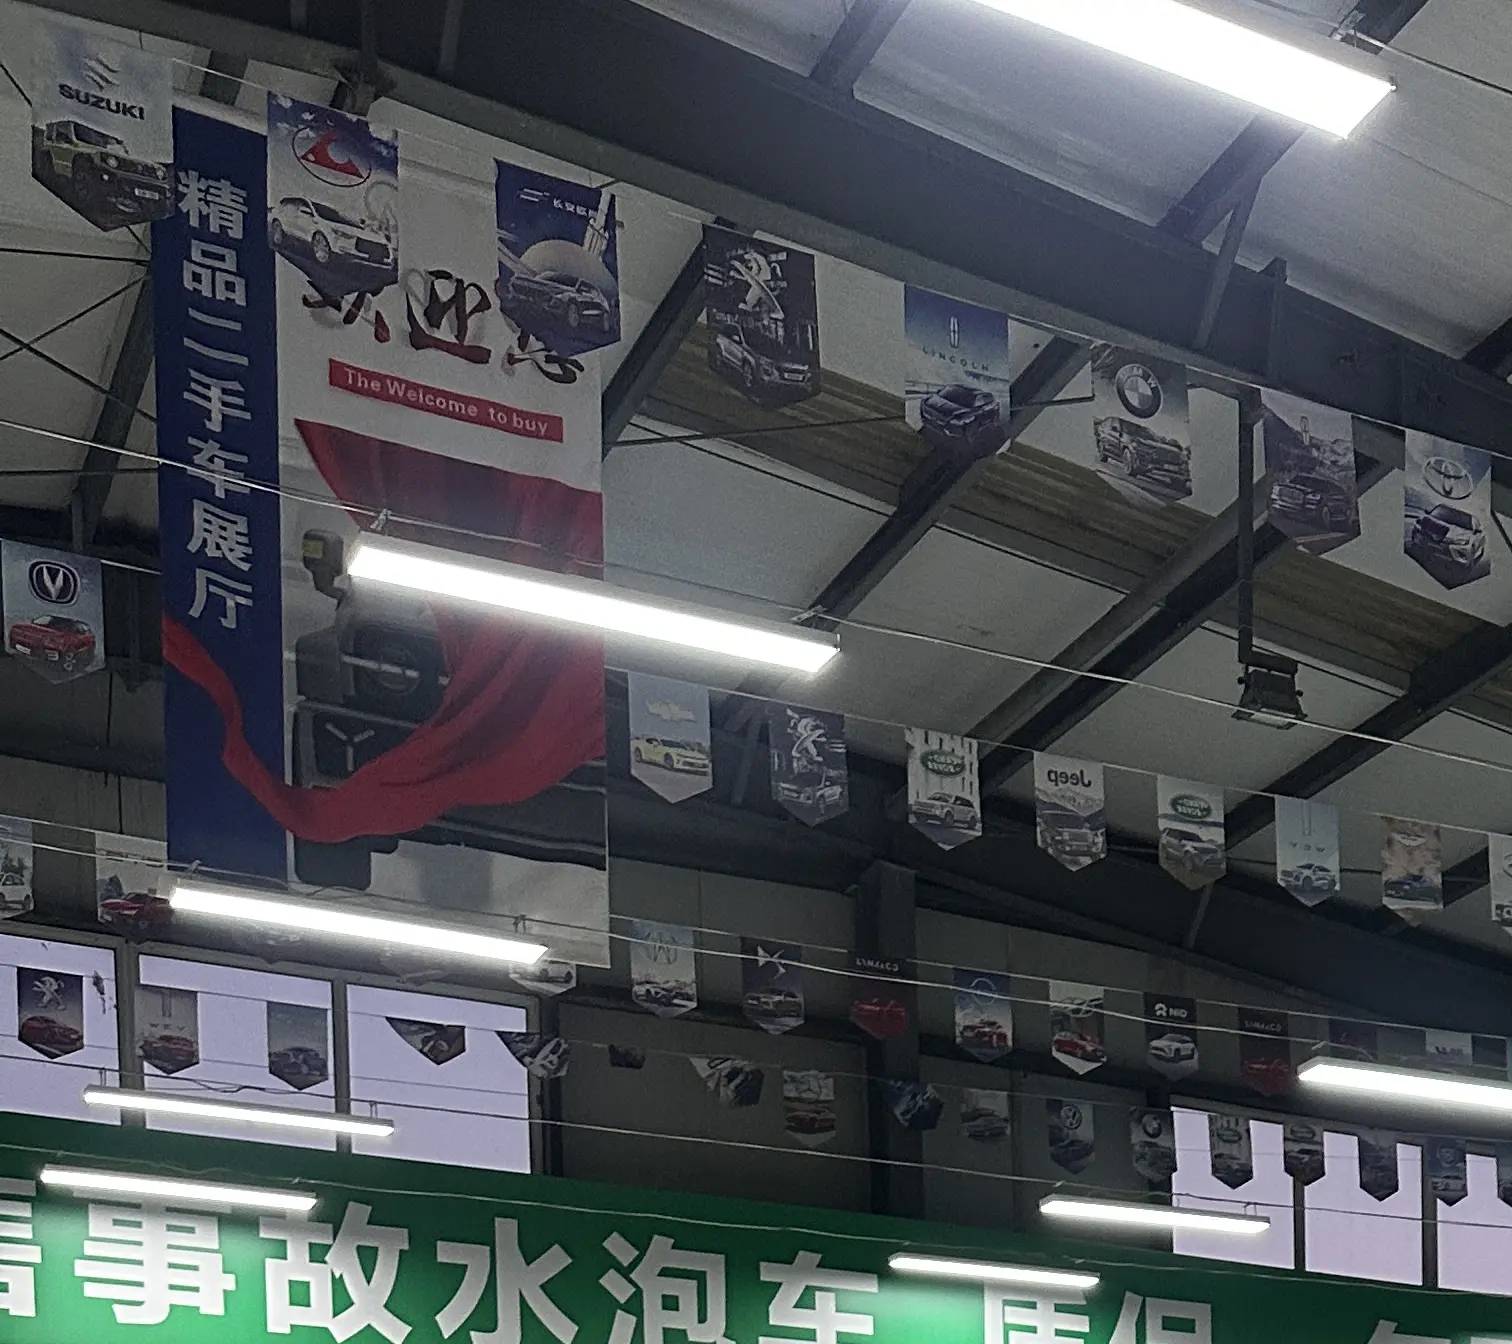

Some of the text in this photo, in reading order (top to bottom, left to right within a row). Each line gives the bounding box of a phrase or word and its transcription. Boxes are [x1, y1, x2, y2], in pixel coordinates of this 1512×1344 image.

[57, 83, 145, 121] SUZUKI
[922, 346, 990, 372] LINCOLN
[177, 168, 254, 632] 精品二手车展厅
[343, 367, 549, 436] The Welcome to buy
